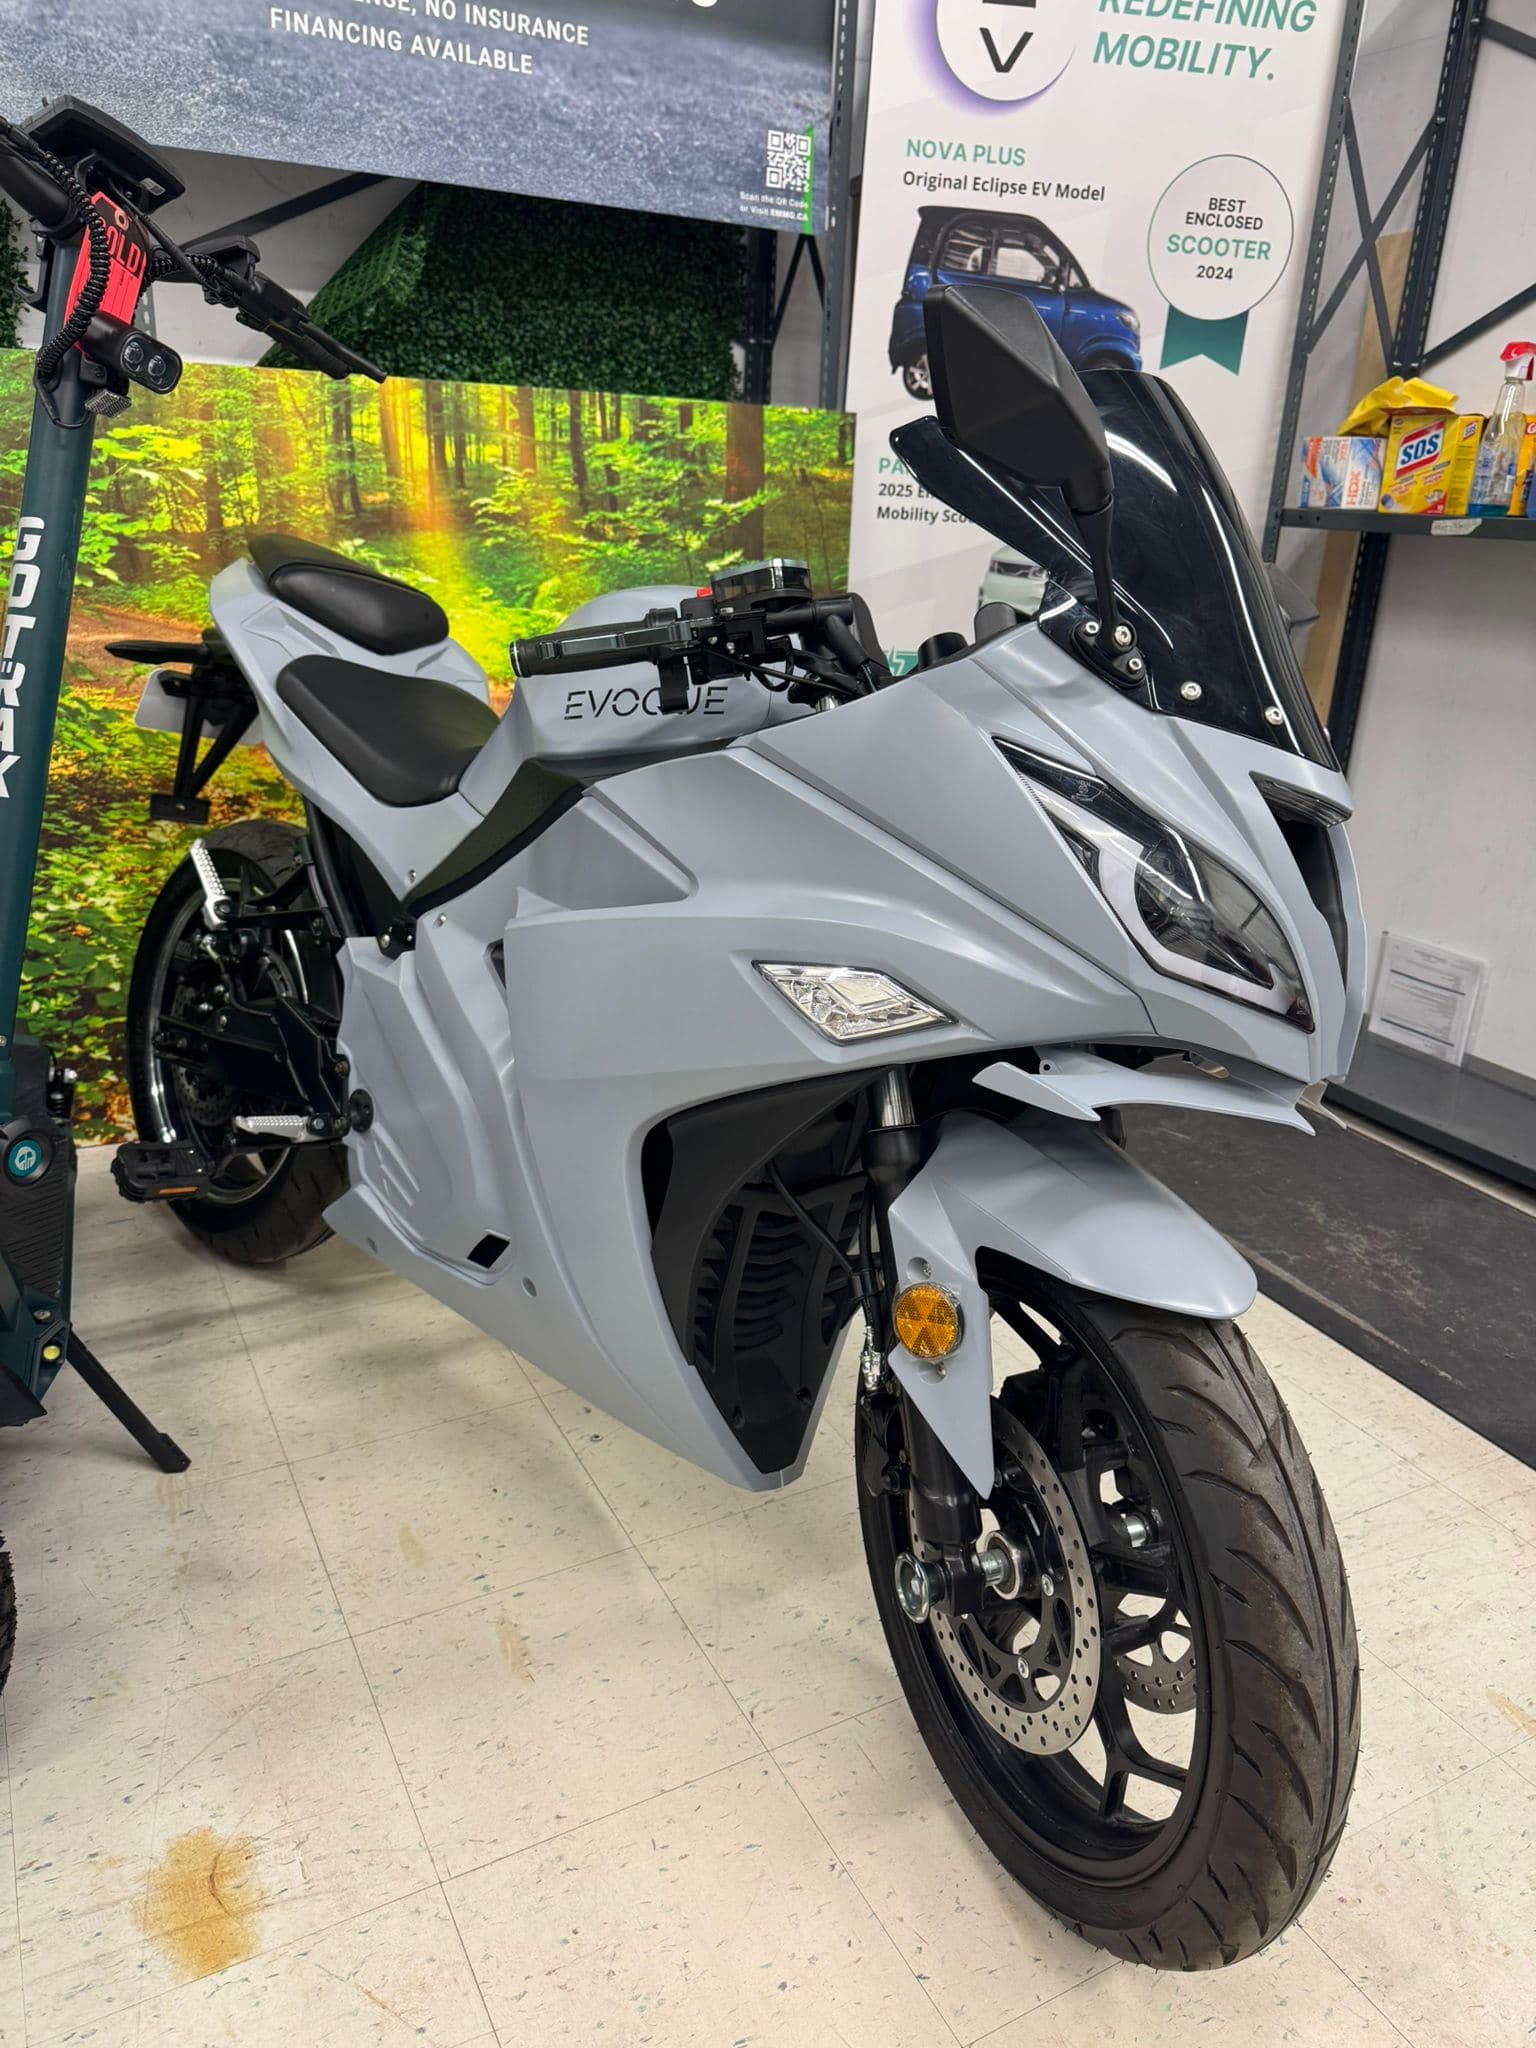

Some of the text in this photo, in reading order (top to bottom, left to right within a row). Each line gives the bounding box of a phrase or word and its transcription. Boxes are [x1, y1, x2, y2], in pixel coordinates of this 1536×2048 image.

[426, 0, 456, 20] NO
[465, 3, 589, 46] INSURANCE
[270, 7, 402, 51] FINANCING
[410, 35, 533, 75] AVAILABLE
[1092, 31, 1274, 80] MOBILITY.
[905, 138, 1026, 166] NOVA PLUS
[903, 171, 1105, 201] Original Eclipse EV Model
[1208, 197, 1246, 213] BEST
[1185, 211, 1263, 230] ENCLOSED
[1167, 234, 1271, 261] SCOOTER
[1196, 265, 1233, 280] 2024
[1400, 433, 1440, 466] SOS
[878, 483, 913, 497] 2025
[876, 506, 939, 525] Mobility
